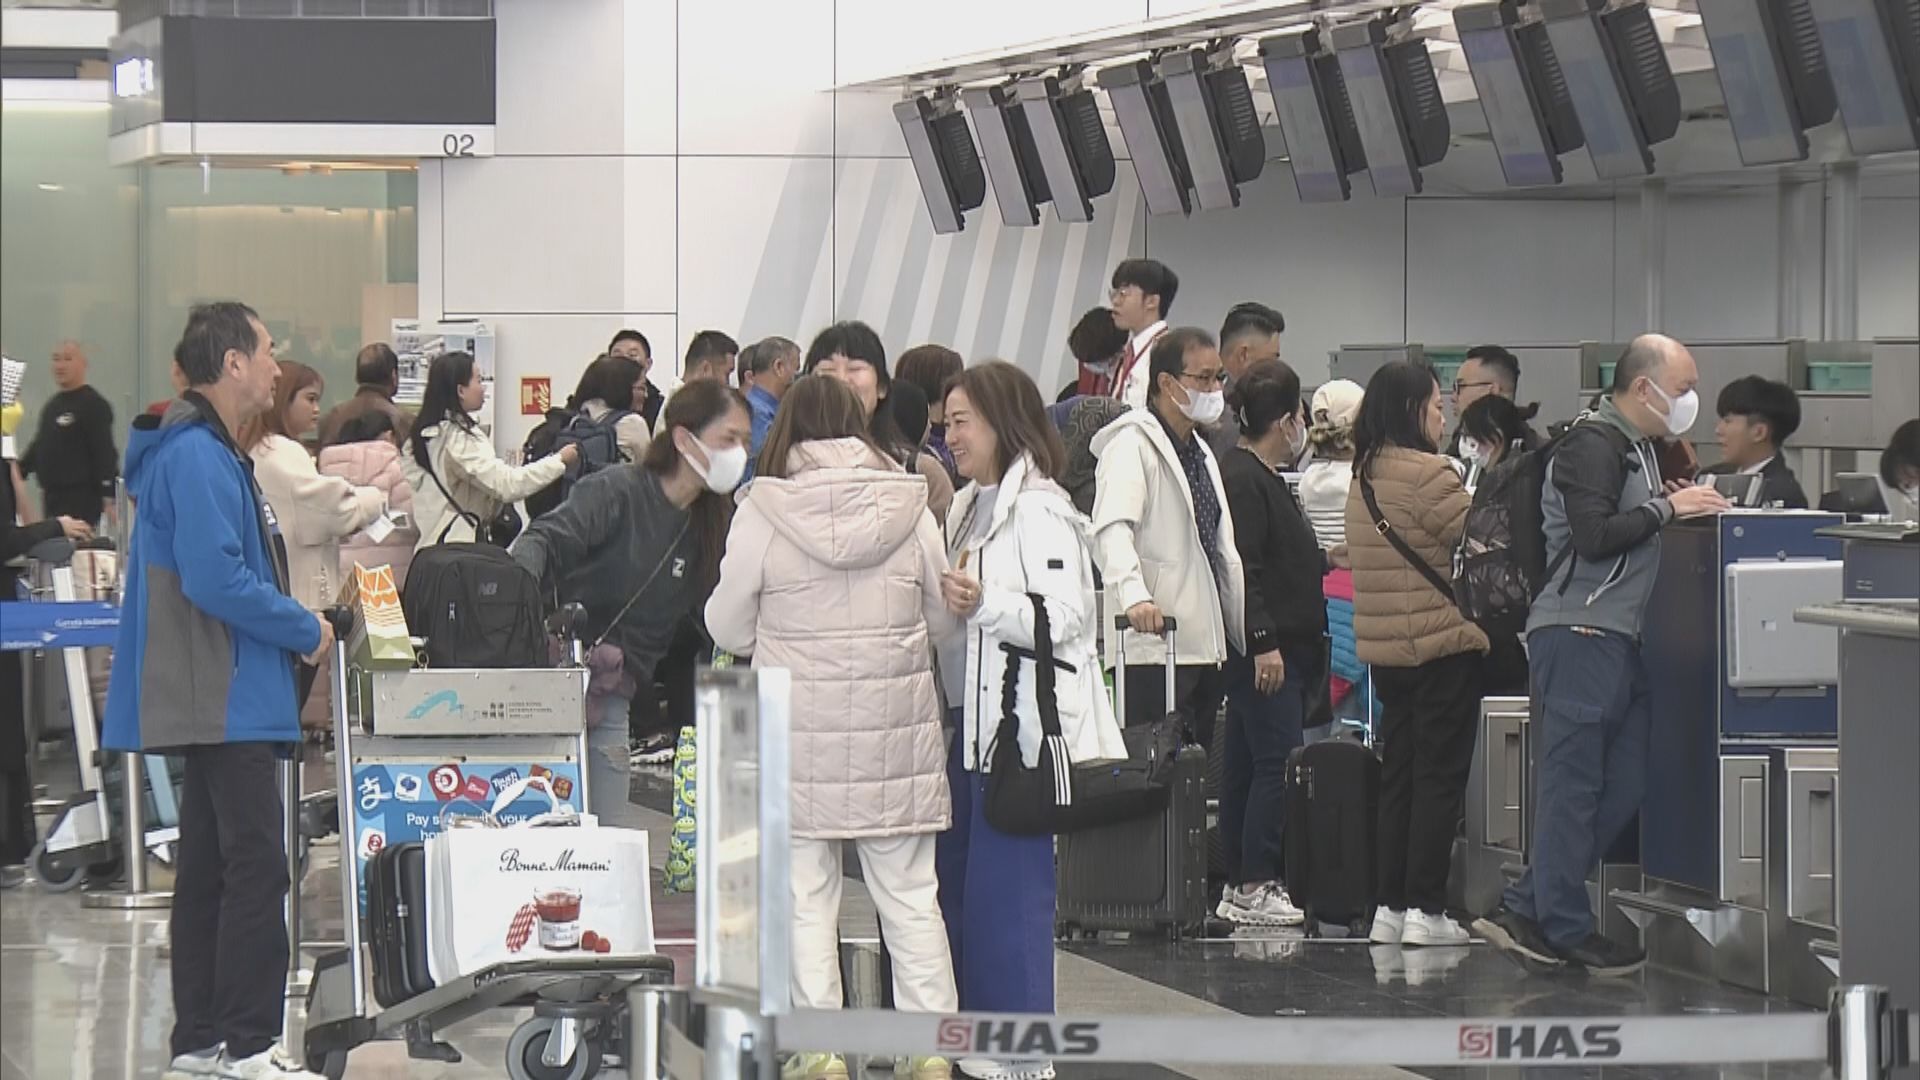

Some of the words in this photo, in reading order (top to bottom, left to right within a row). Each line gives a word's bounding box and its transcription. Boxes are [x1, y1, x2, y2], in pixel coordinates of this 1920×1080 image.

[443, 134, 475, 158] 02
[406, 812, 430, 828] Pay
[499, 848, 548, 872] Bonne
